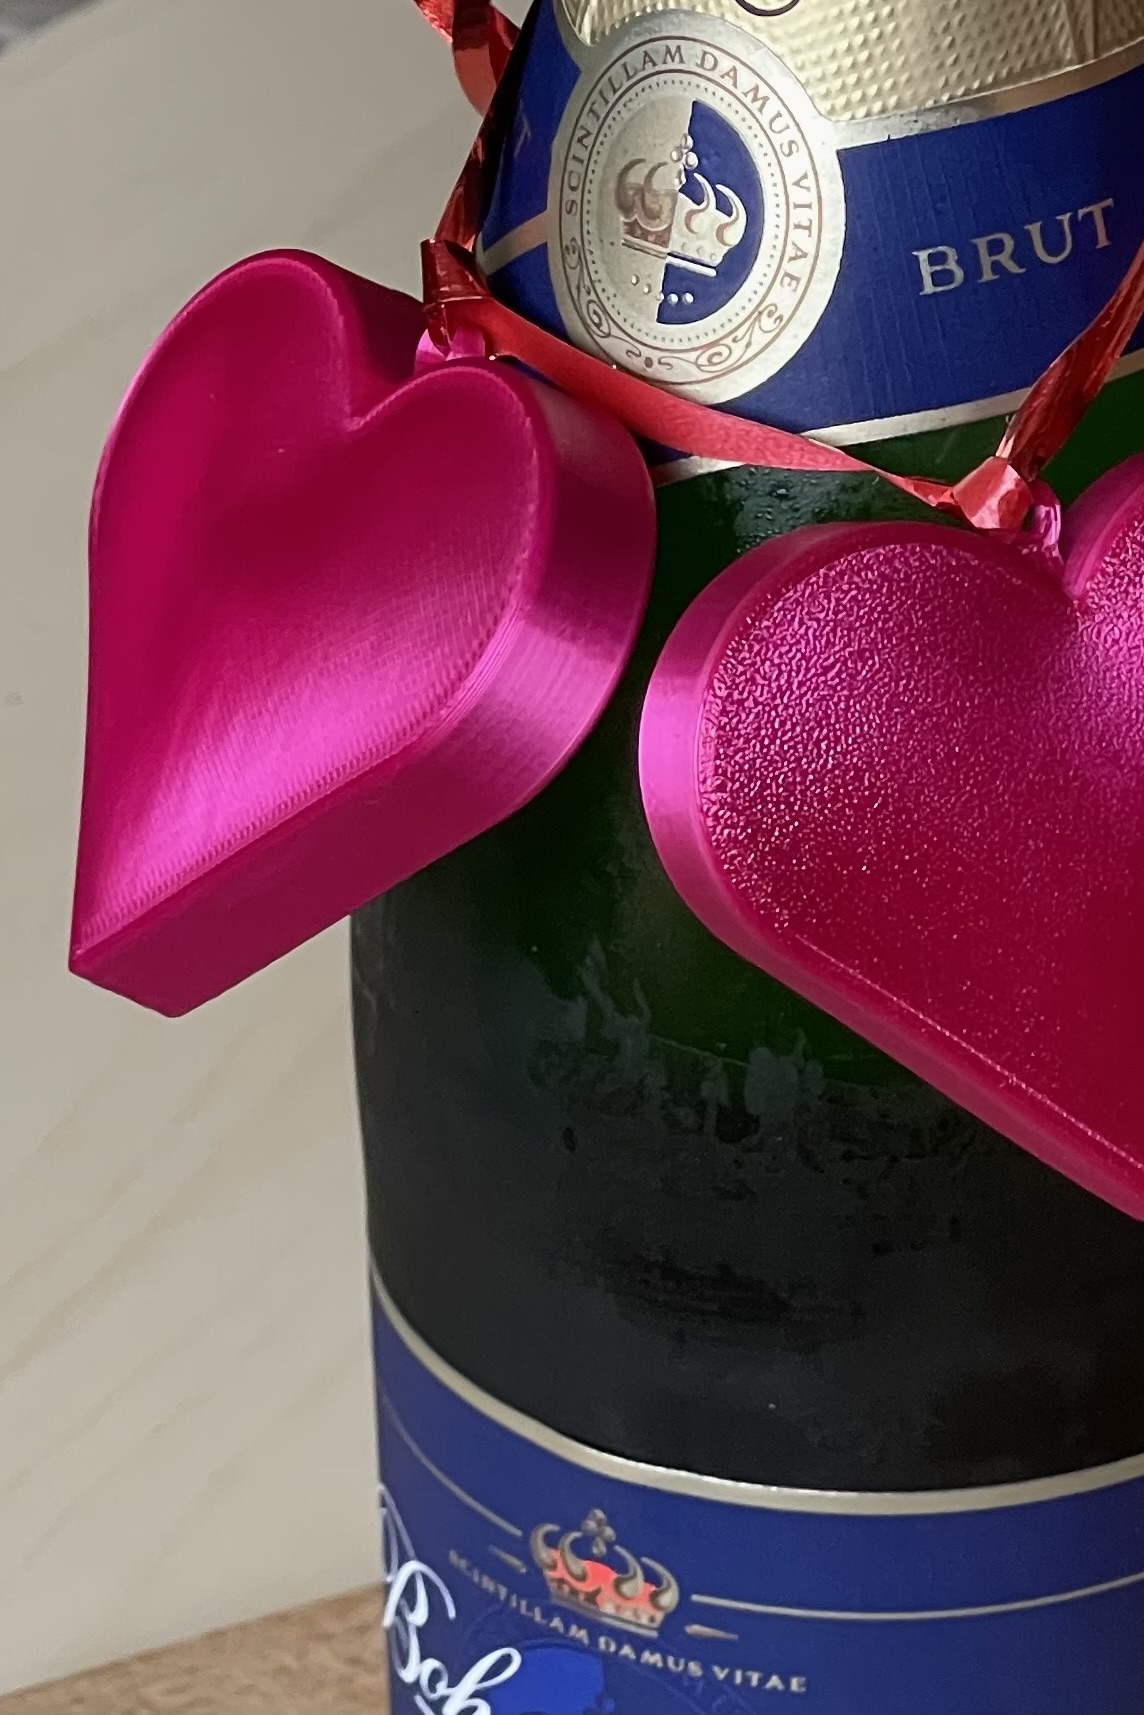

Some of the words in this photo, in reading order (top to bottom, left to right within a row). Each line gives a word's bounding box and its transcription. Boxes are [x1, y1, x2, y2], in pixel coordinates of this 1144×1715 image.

[565, 45, 686, 217] SCINTILLAM
[696, 51, 800, 158] DAMUS
[780, 170, 813, 292] VITAE
[912, 198, 1115, 296] BRUT
[598, 1635, 703, 1678] DAMUS
[711, 1663, 808, 1693] VITAE
